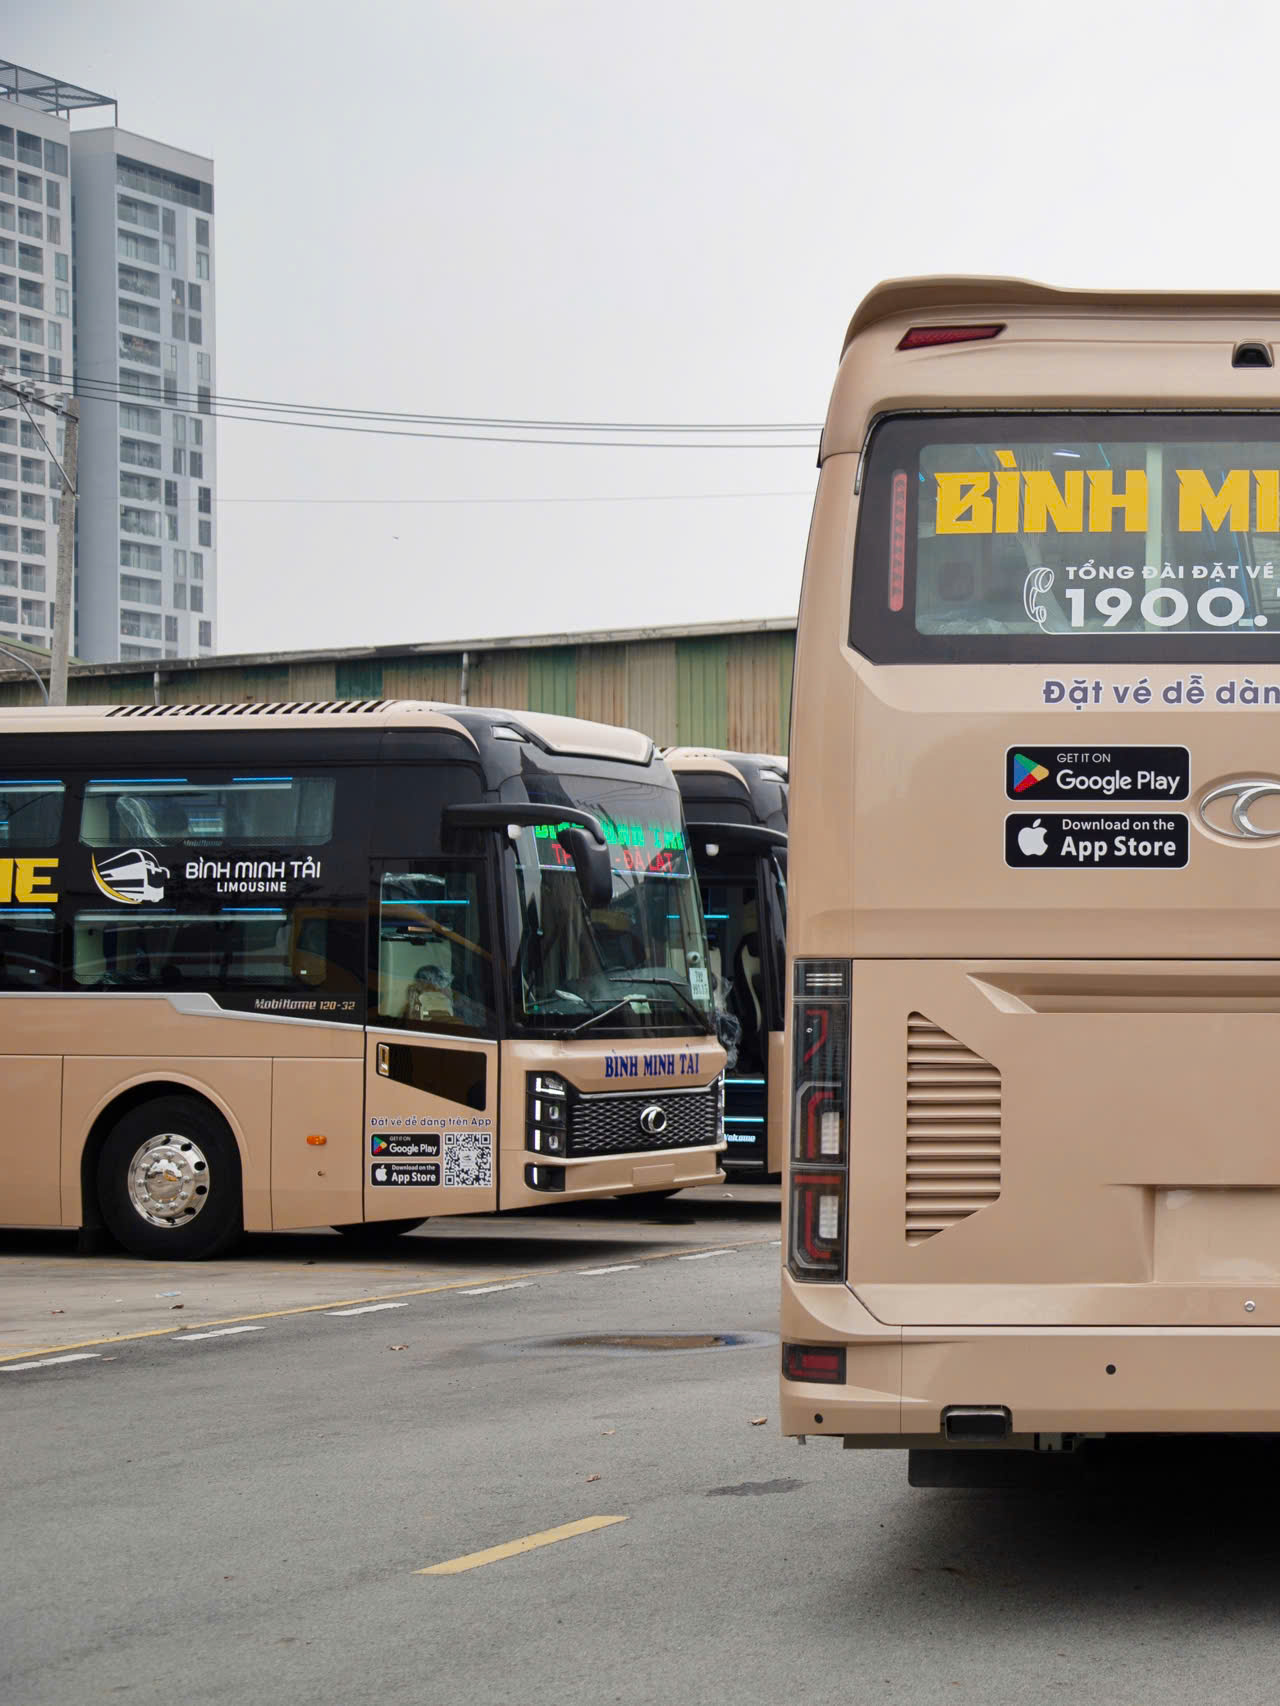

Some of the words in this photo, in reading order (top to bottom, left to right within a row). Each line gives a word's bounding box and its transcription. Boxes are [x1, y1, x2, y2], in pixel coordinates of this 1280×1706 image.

[934, 450, 1148, 534] BÌNH
[1066, 559, 1134, 580] TỔNG
[1142, 562, 1184, 579] ĐÀI
[1192, 562, 1239, 582] ĐẶT
[1245, 562, 1274, 579] VÉ
[1042, 679, 1103, 711] Đặt
[1113, 678, 1152, 704] vé
[1162, 675, 1205, 704] dễ
[1056, 753, 1079, 763] GET
[1081, 753, 1090, 763] IT
[1092, 753, 1111, 763] ON
[1056, 769, 1132, 795] Google
[1137, 770, 1180, 795] Play
[1062, 818, 1130, 831] Download
[1133, 820, 1150, 831] on
[1153, 818, 1175, 831] the
[1060, 836, 1108, 862] App
[1114, 836, 1177, 857] Store
[185, 856, 230, 879] BÌNH
[234, 861, 285, 879] MINH
[290, 856, 321, 879] TẢI
[217, 881, 287, 893] LIMOUSINE
[320, 1000, 356, 1011] 120-32
[604, 1049, 638, 1078] BÌNH
[643, 1054, 675, 1077] MINH
[471, 1117, 492, 1127] App
[389, 1143, 419, 1156] Google
[420, 1143, 437, 1155] Play
[391, 1172, 410, 1183] App
[411, 1172, 436, 1182] Store
